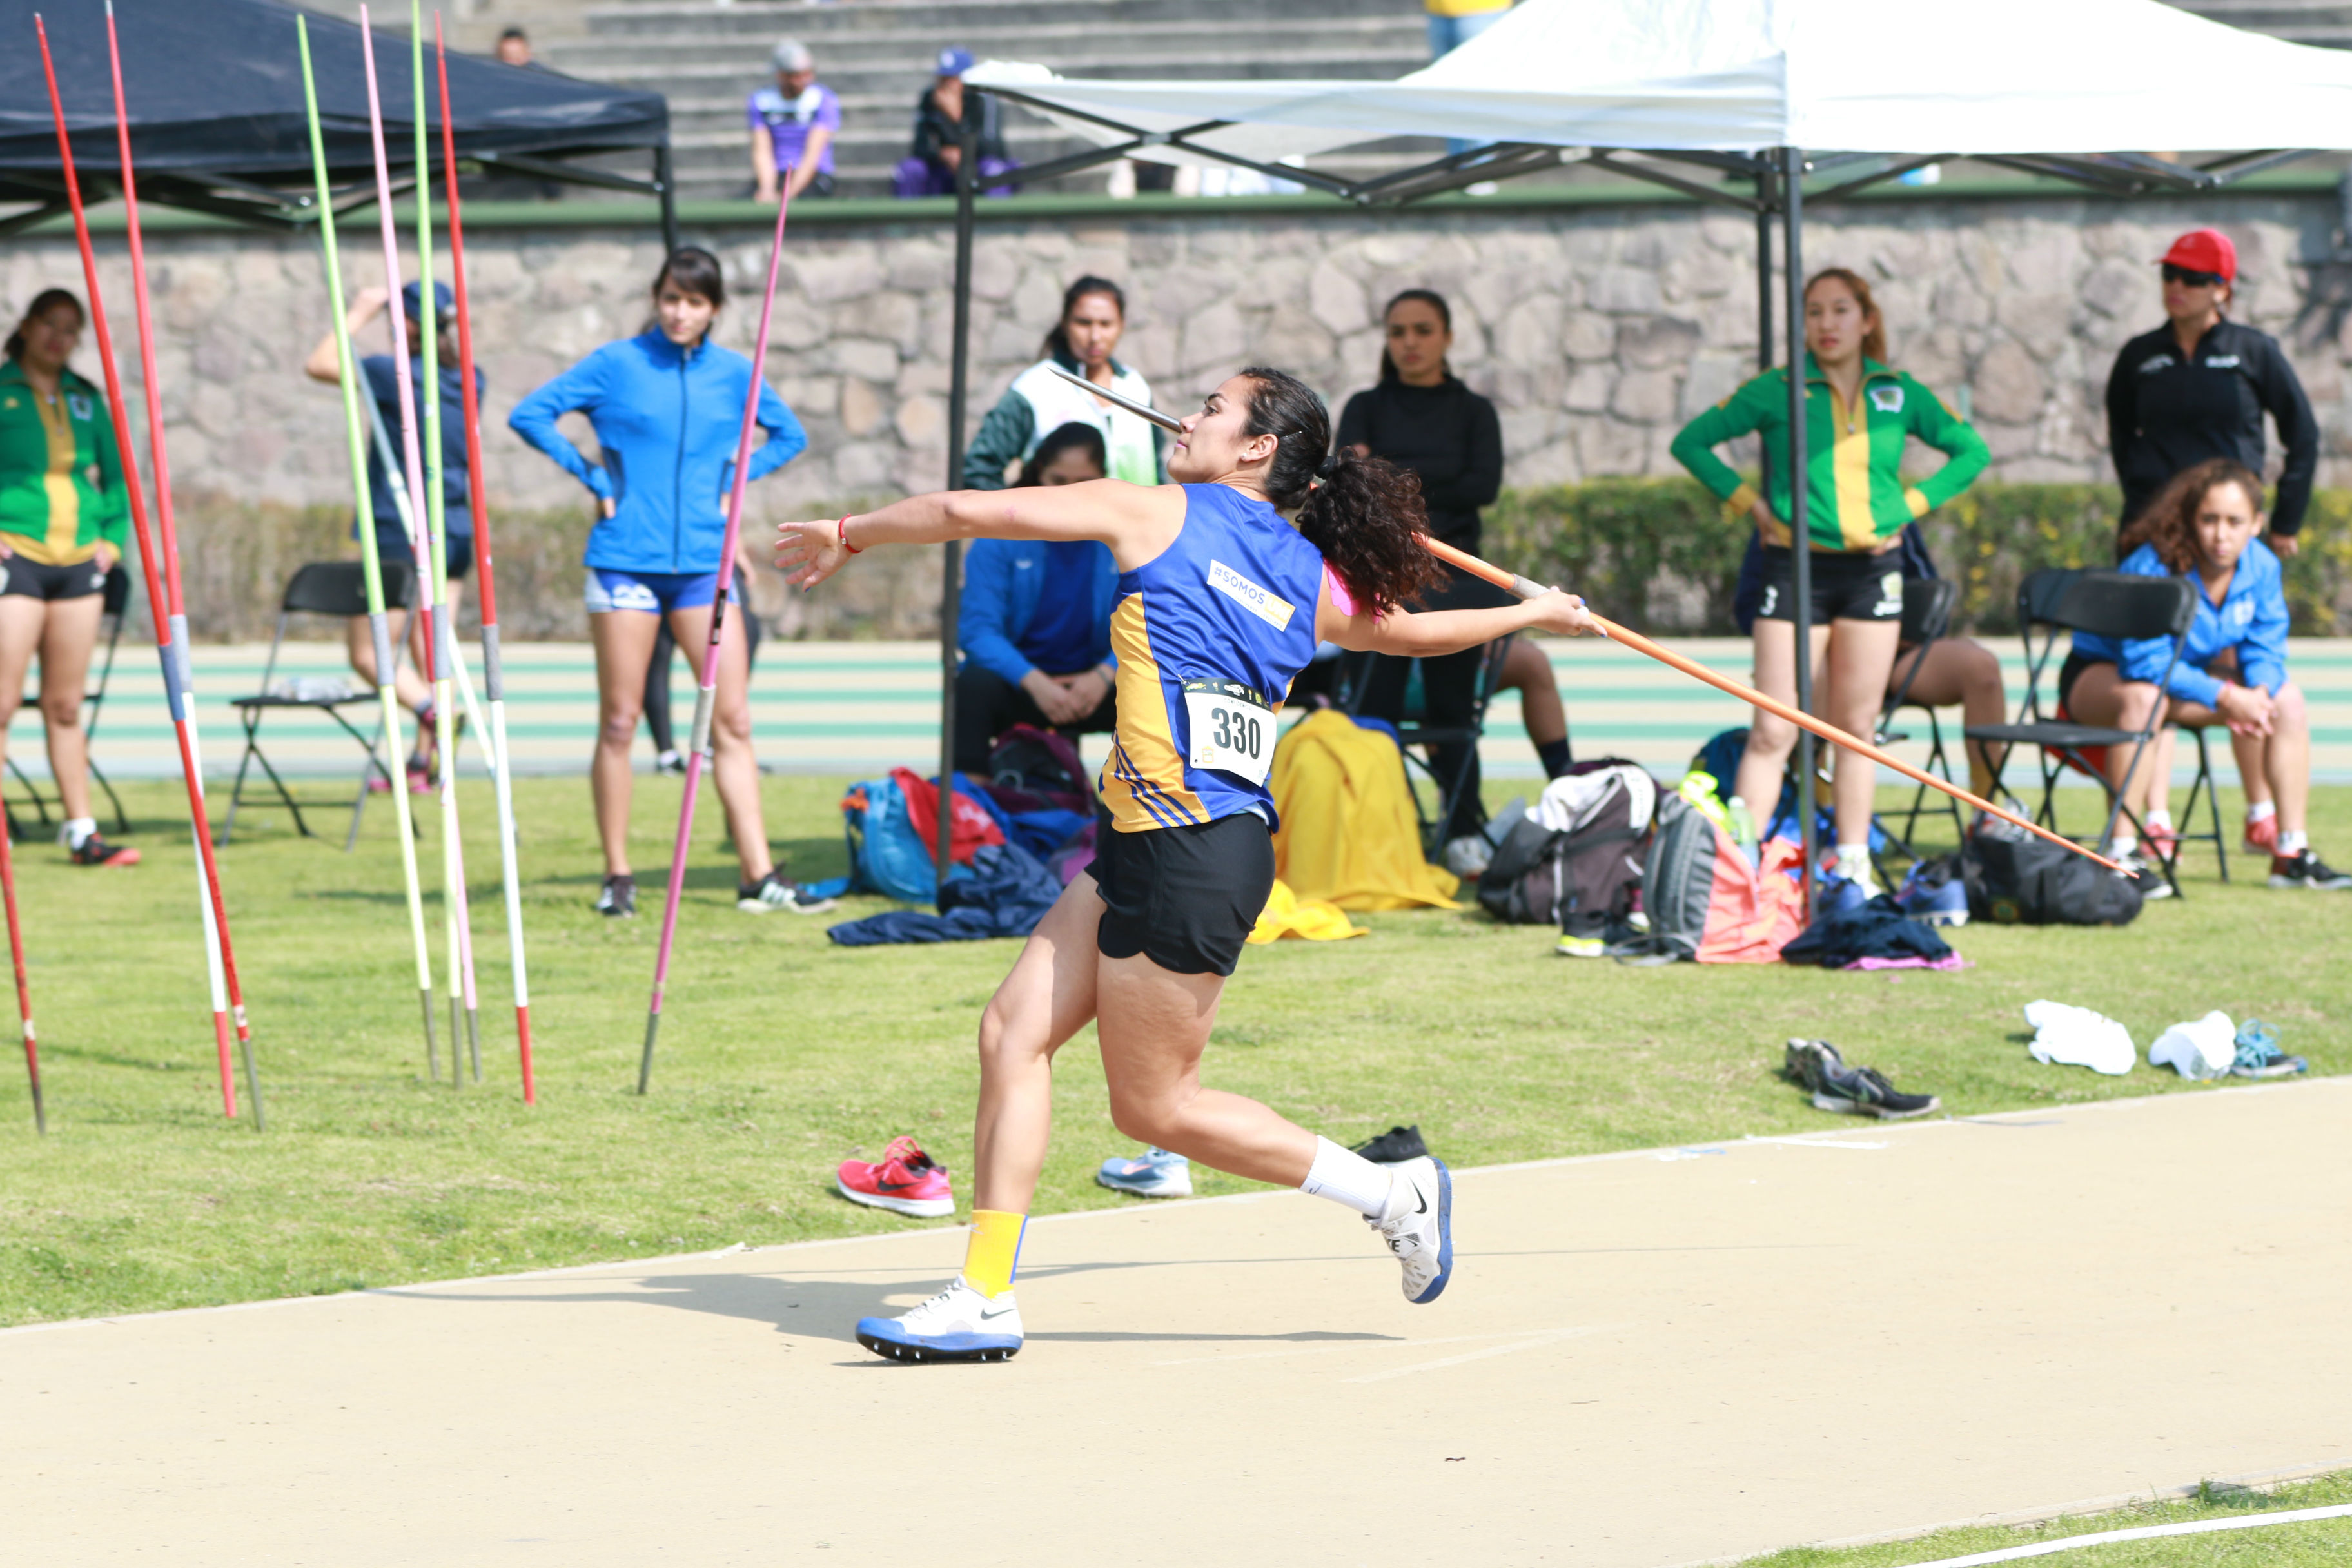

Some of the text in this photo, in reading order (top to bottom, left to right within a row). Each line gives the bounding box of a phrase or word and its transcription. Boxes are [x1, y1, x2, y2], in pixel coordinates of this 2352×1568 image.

[1214, 567, 1266, 605] #SOMOS
[1267, 597, 1291, 620] UNI
[1211, 707, 1261, 760] 330
